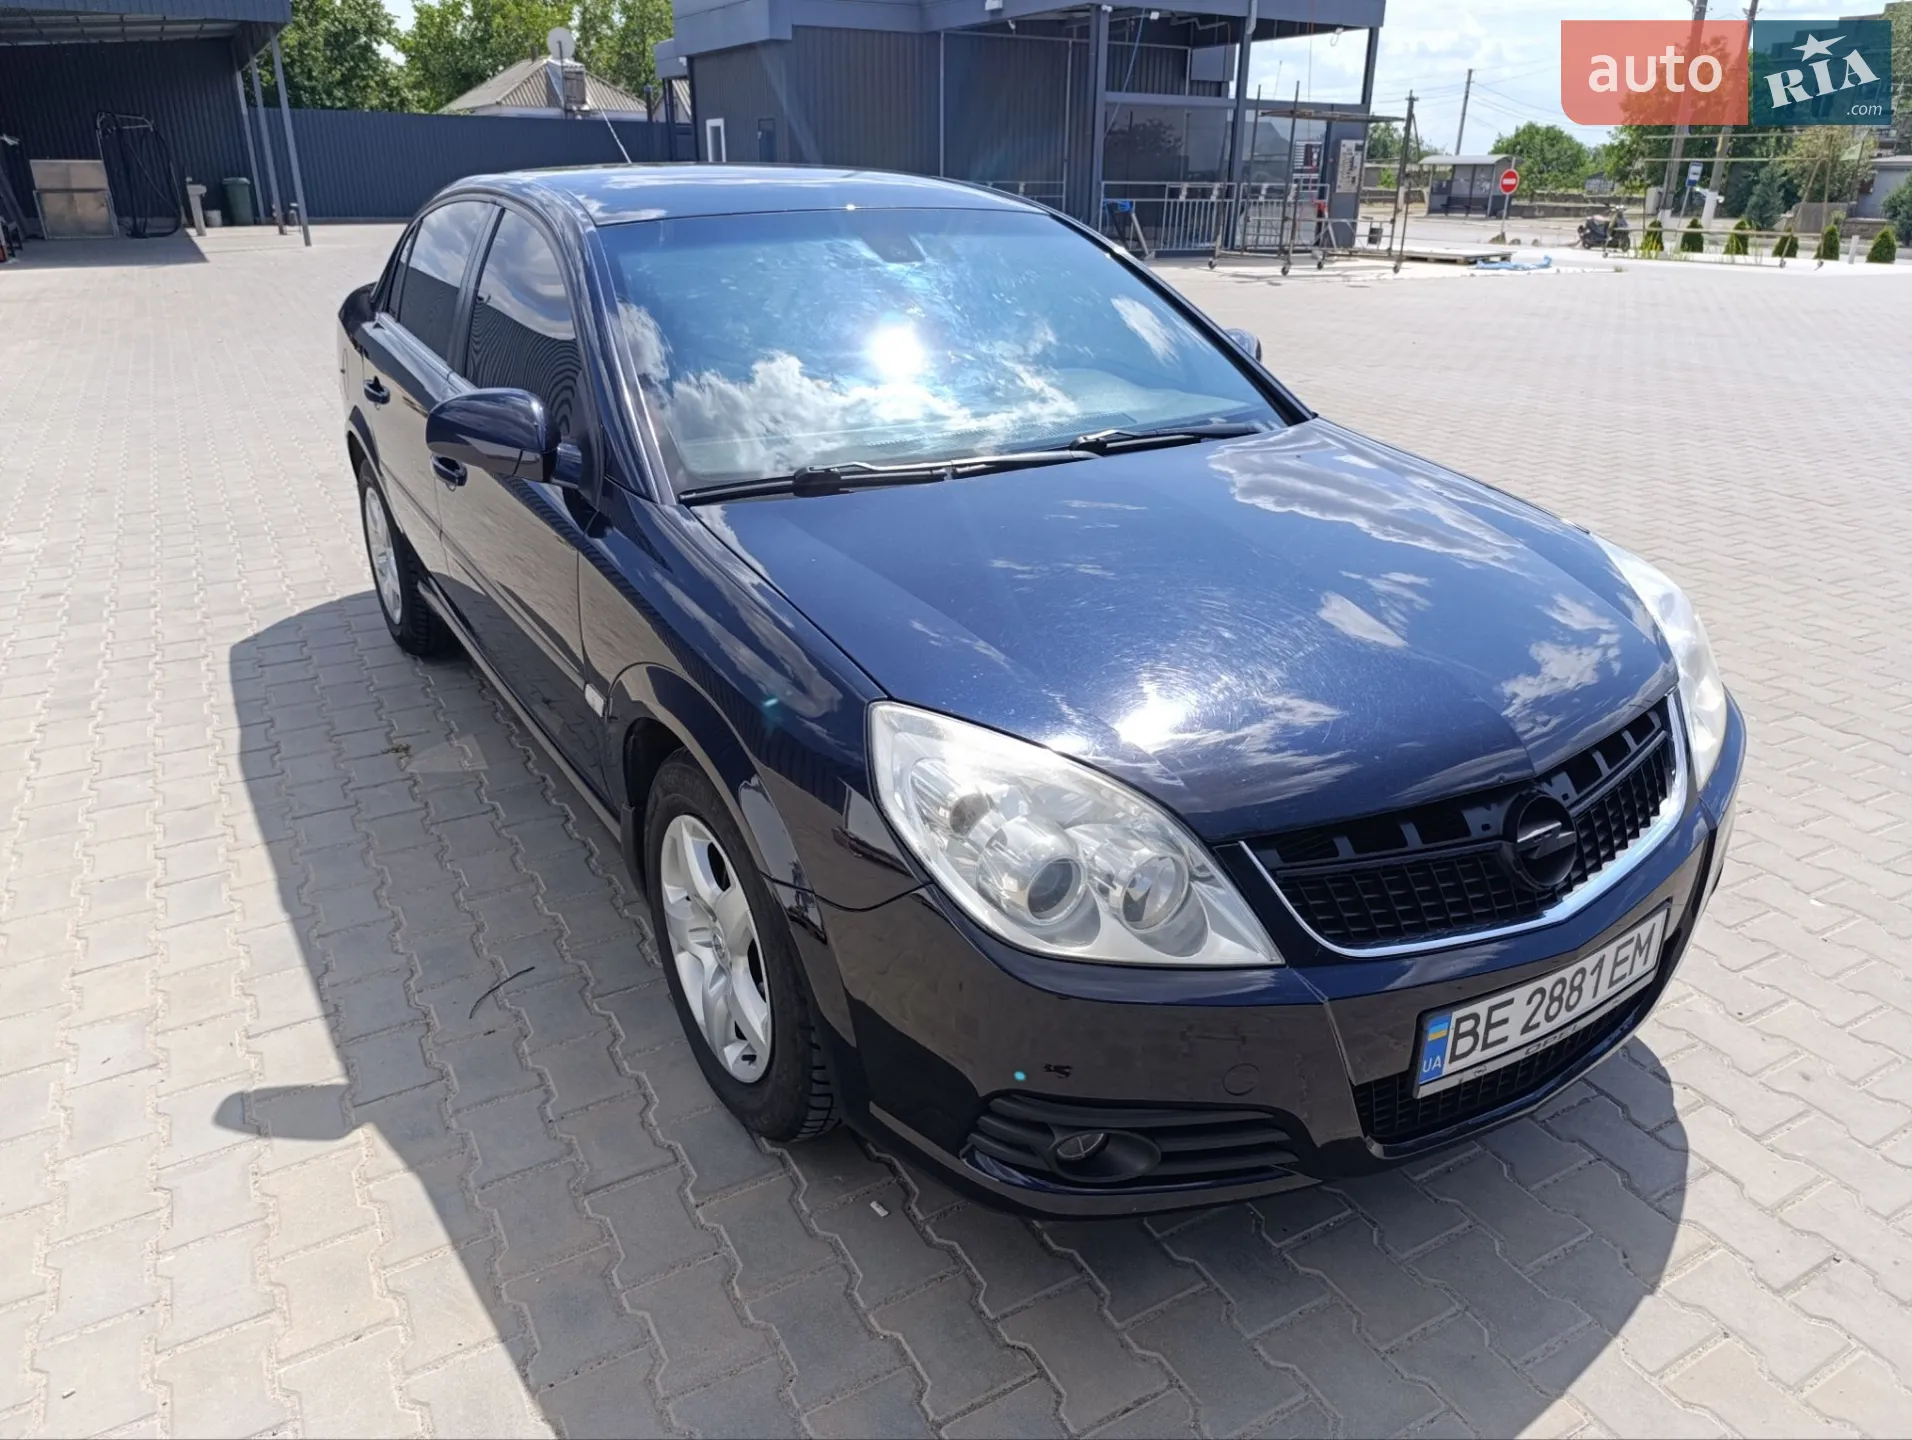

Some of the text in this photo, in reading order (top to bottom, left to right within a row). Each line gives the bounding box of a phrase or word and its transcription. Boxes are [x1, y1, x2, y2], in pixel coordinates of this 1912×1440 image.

[1449, 922, 1656, 1065] BE 2881 EM
[1422, 1055, 1442, 1073] UA
